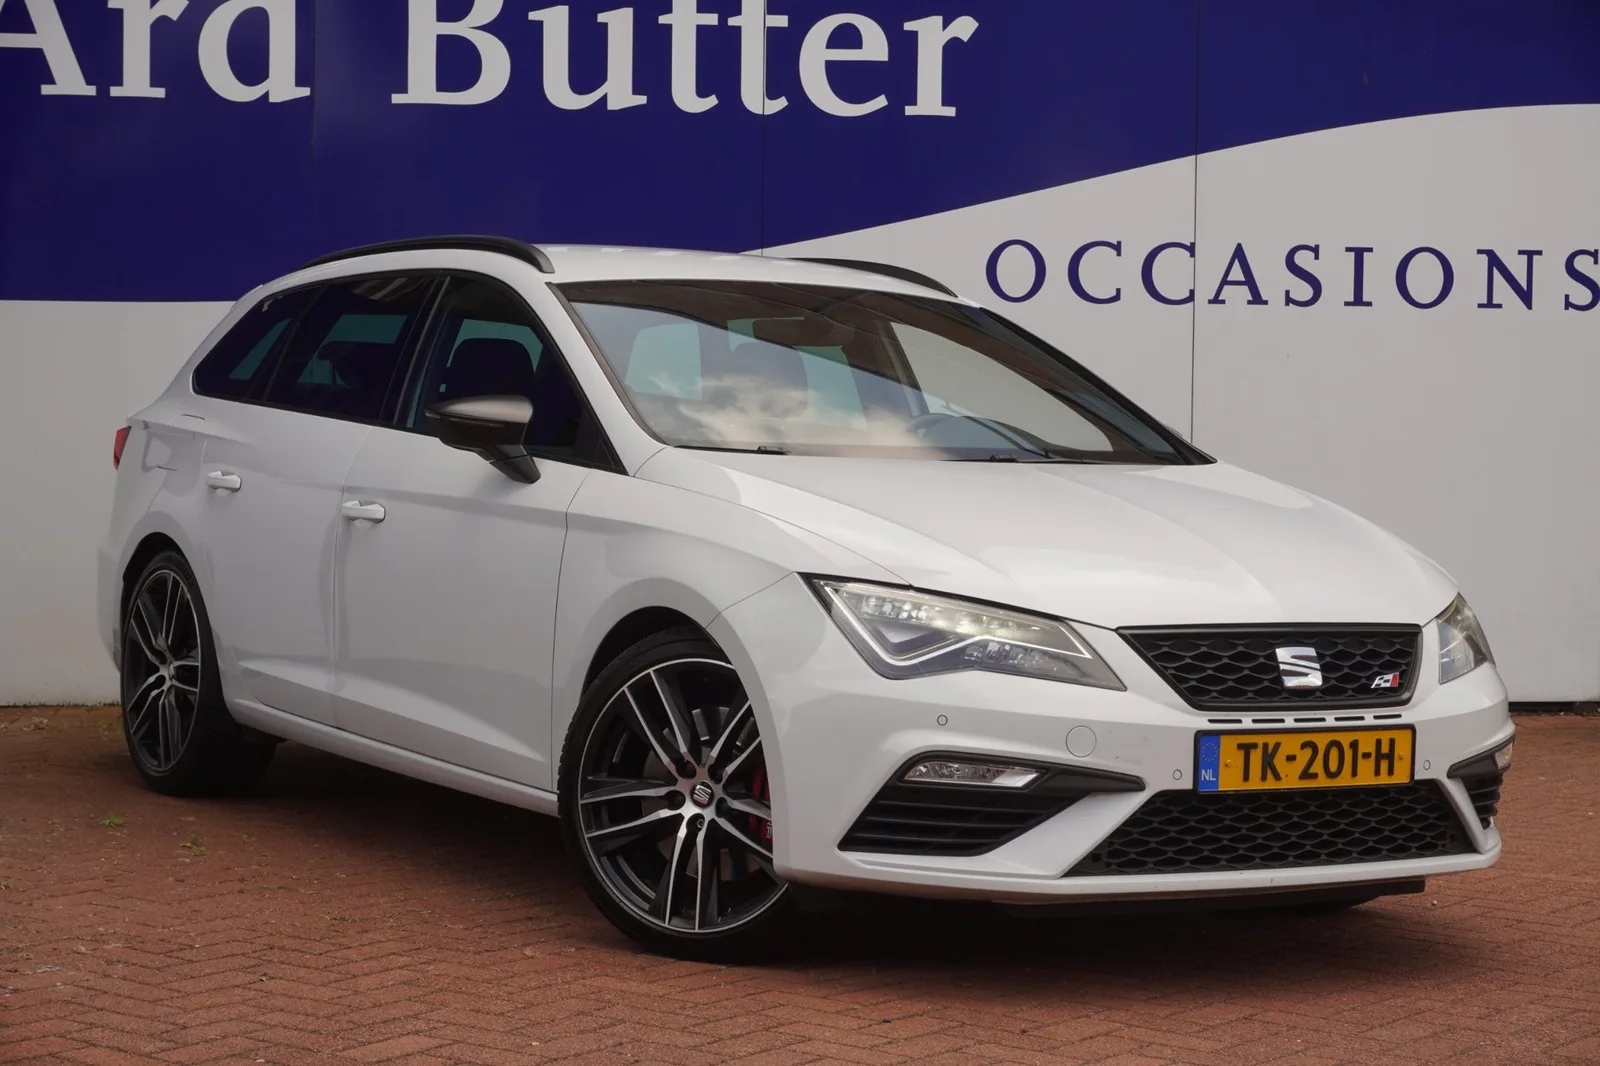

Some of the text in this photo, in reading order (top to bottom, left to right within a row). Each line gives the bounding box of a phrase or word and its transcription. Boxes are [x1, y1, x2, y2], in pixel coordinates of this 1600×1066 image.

[0, 0, 979, 117] Ard Butter
[986, 239, 1600, 311] OCCASIONS
[1201, 738, 1396, 782] NL TK-201-H
